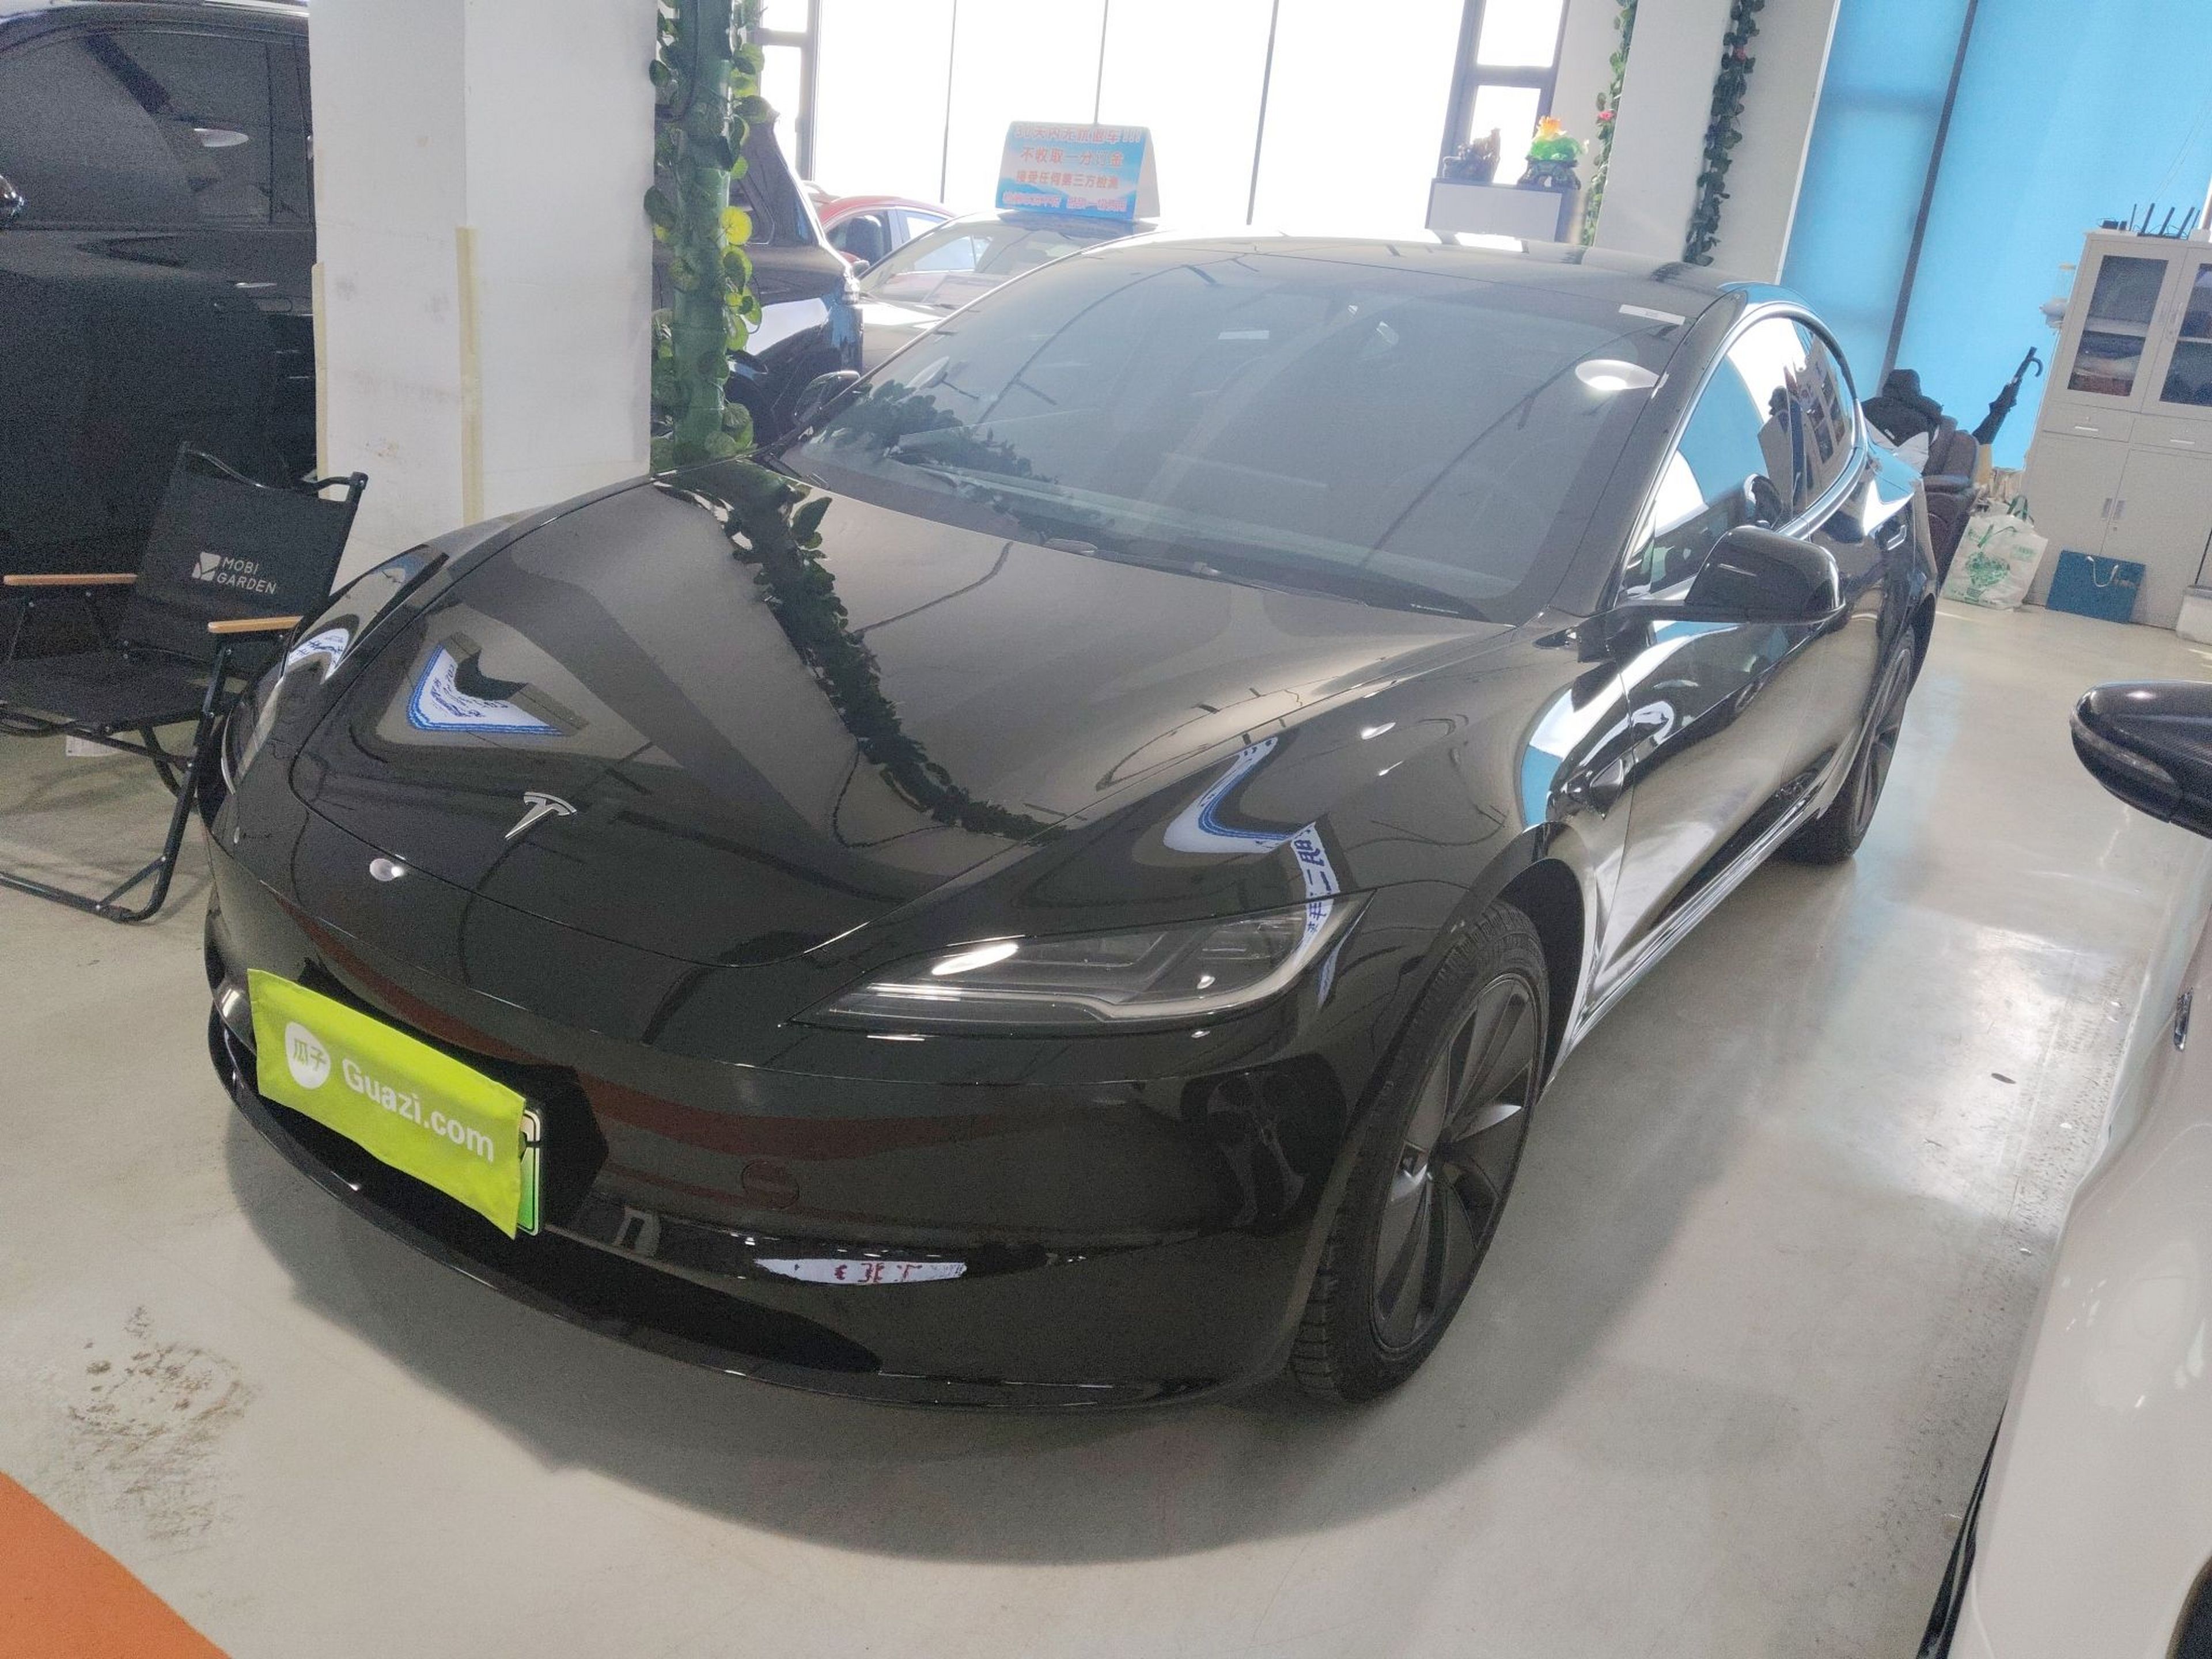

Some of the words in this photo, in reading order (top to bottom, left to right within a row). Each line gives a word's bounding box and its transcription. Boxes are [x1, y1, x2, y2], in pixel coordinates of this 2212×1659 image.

[222, 556, 259, 574] MOBI
[217, 573, 276, 594] GARDEN
[293, 1037, 327, 1071] 瓜子
[343, 1058, 495, 1164] Guazi.com
